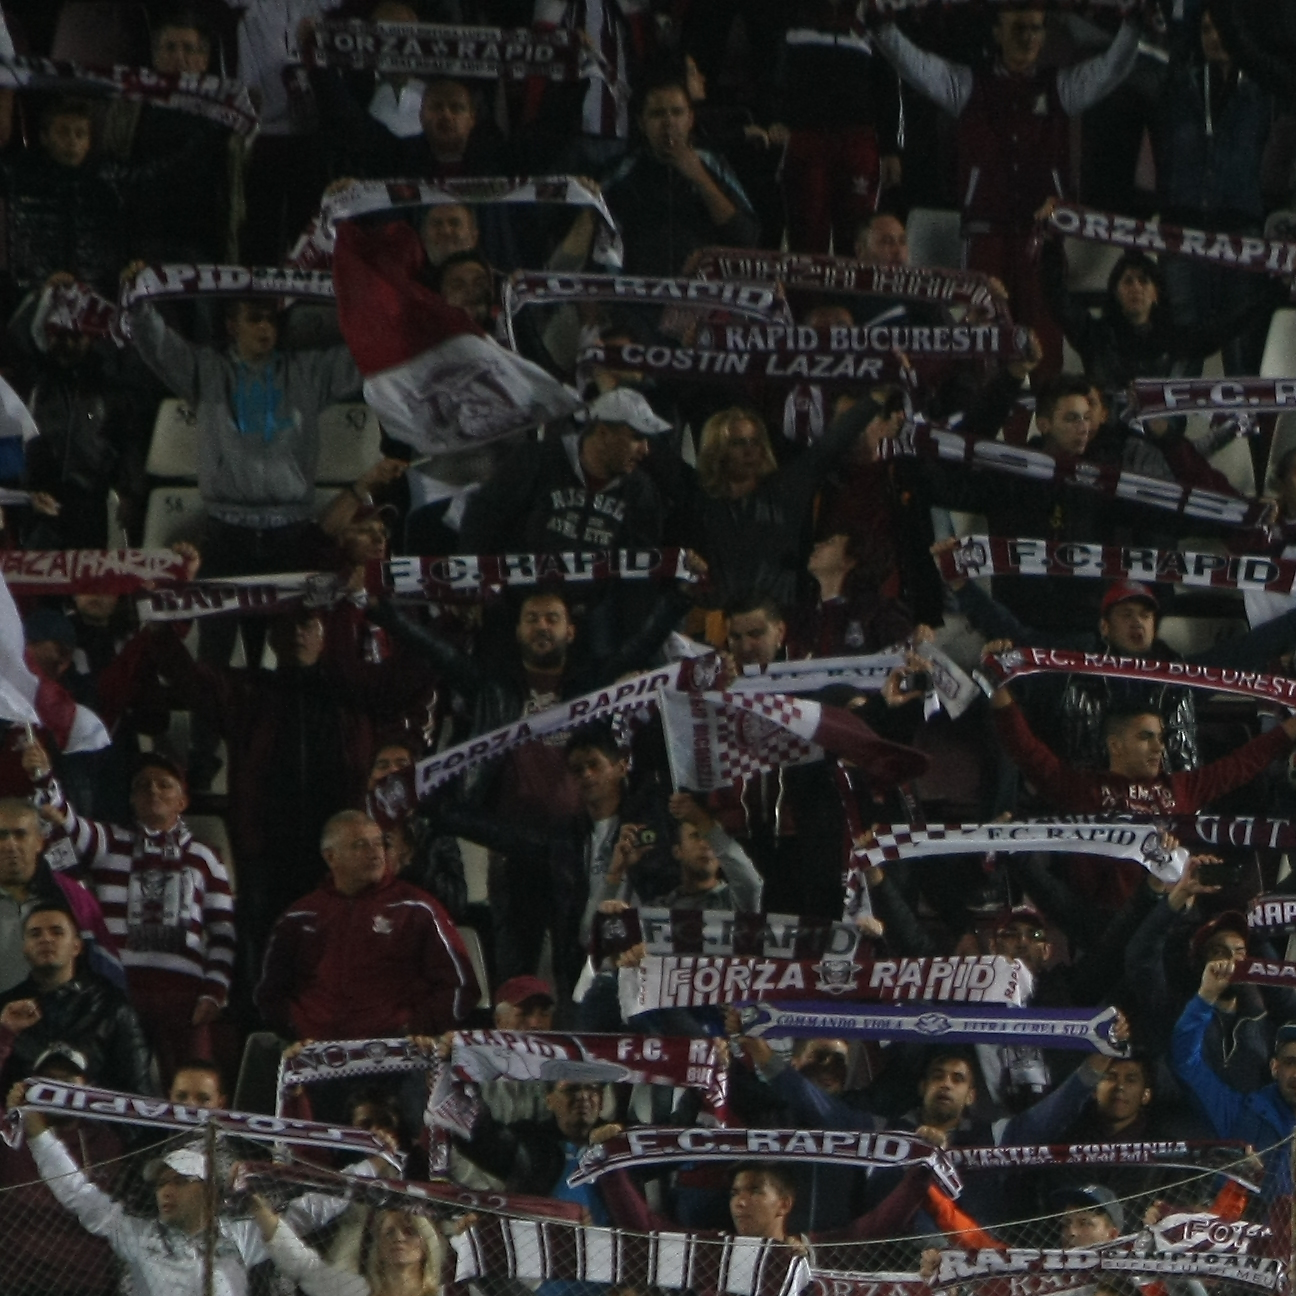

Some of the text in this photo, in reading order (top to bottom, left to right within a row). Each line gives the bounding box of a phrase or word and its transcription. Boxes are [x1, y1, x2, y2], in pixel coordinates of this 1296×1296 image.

[1050, 207, 1167, 251] ORZA
[724, 325, 1000, 353] RAPID BUCURESTI
[622, 343, 750, 375] COSTIN
[1163, 382, 1260, 409] F.C.
[498, 549, 662, 583] RAPID
[1007, 540, 1281, 585] F.C. RAPID
[1031, 647, 1075, 668] F.C.
[422, 674, 670, 782] FORZA RAPID
[1046, 829, 1136, 847] RAPID
[669, 962, 996, 997] FORZA RAPID
[776, 1013, 857, 1029] COMMANDO
[1063, 1022, 1089, 1036] SUD
[616, 1038, 669, 1061] F.C.
[627, 1128, 912, 1166] F.C. RAPID
[938, 1248, 1101, 1284] RAPID
